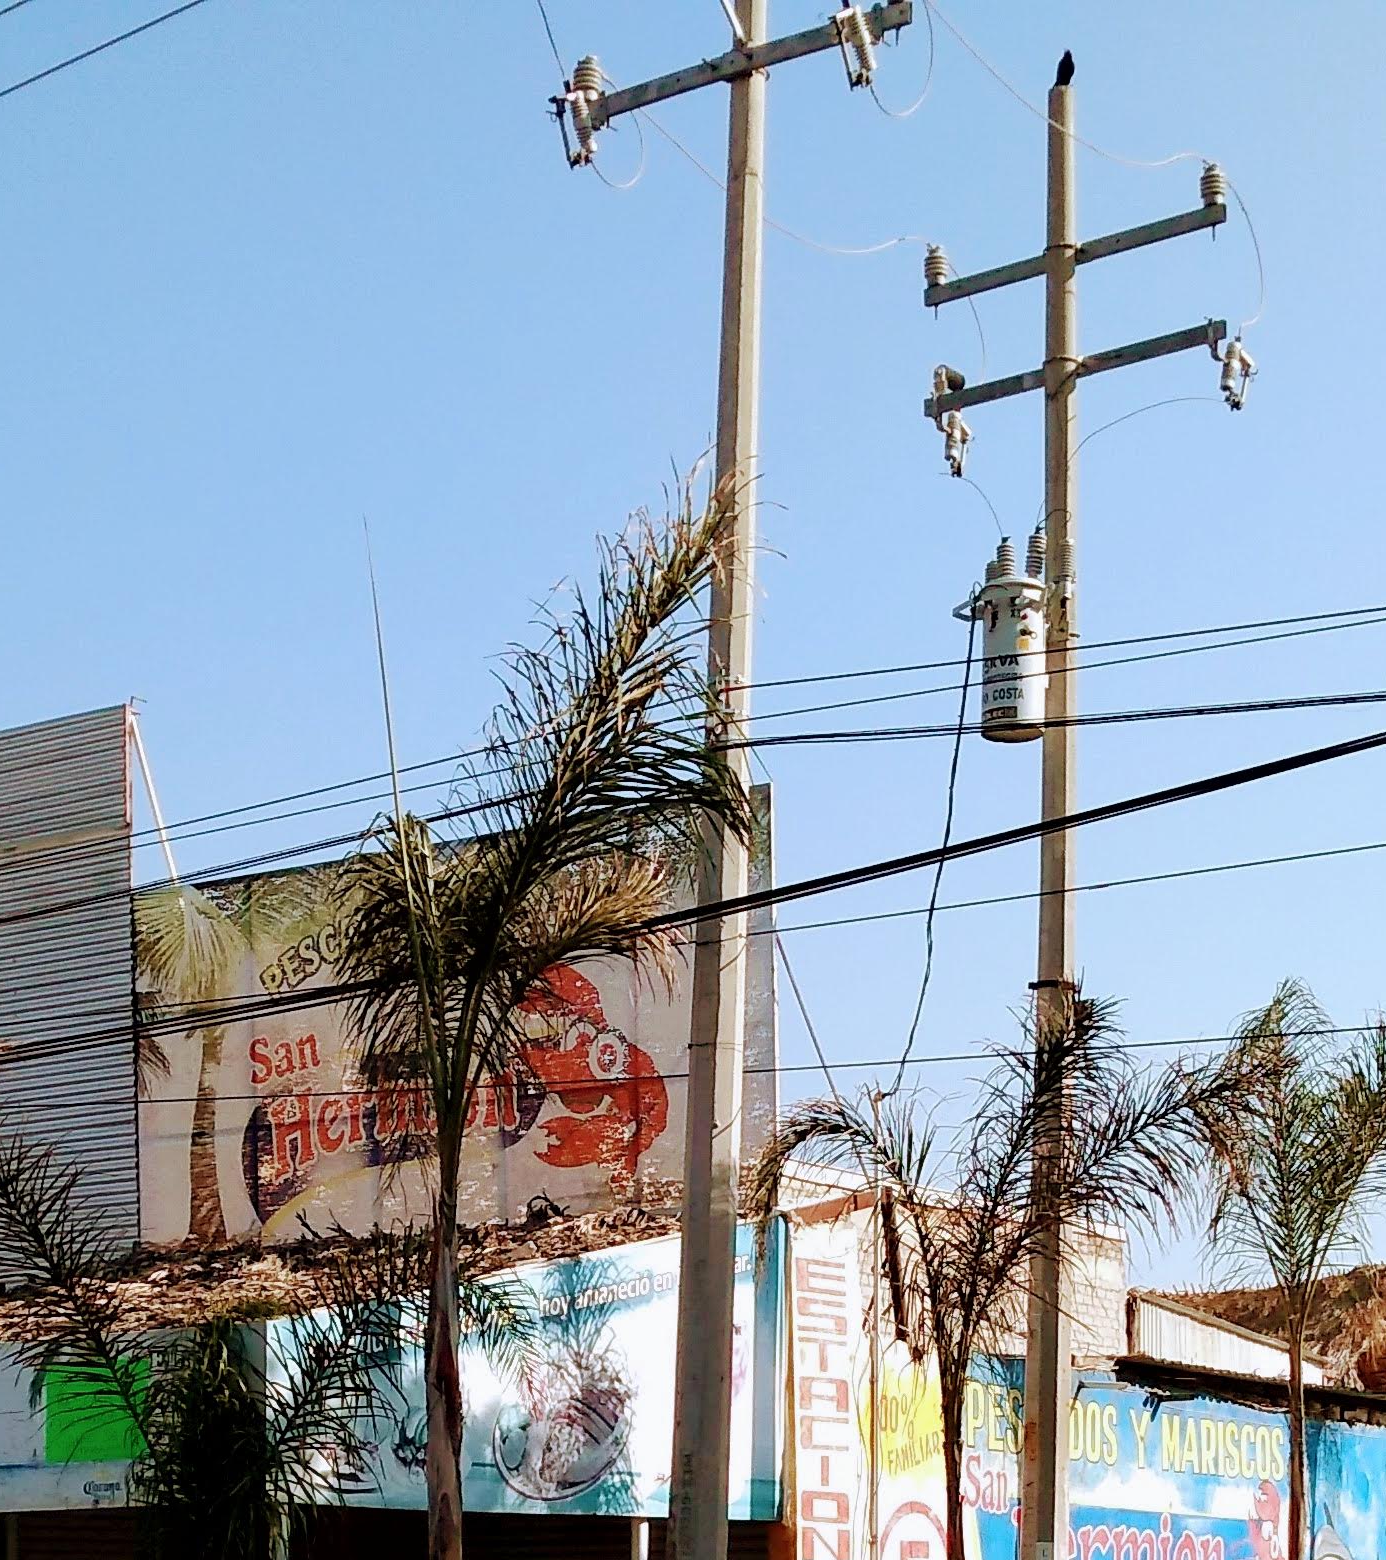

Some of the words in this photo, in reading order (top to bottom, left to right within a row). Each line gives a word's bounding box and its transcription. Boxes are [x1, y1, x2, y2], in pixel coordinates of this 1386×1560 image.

[993, 687, 1024, 702] COSTA
[249, 1033, 321, 1084] San
[539, 1291, 570, 1319] hoy
[574, 1269, 650, 1311] amaneció
[653, 1270, 673, 1294] en
[734, 1255, 753, 1275] ar.
[879, 1391, 915, 1442] 00%
[963, 1381, 1117, 1467] PESDOS
[1130, 1409, 1151, 1469] Y
[1161, 1411, 1286, 1481] MARISCOS
[886, 1427, 941, 1478] FAMILIAR
[963, 1453, 1010, 1514] San
